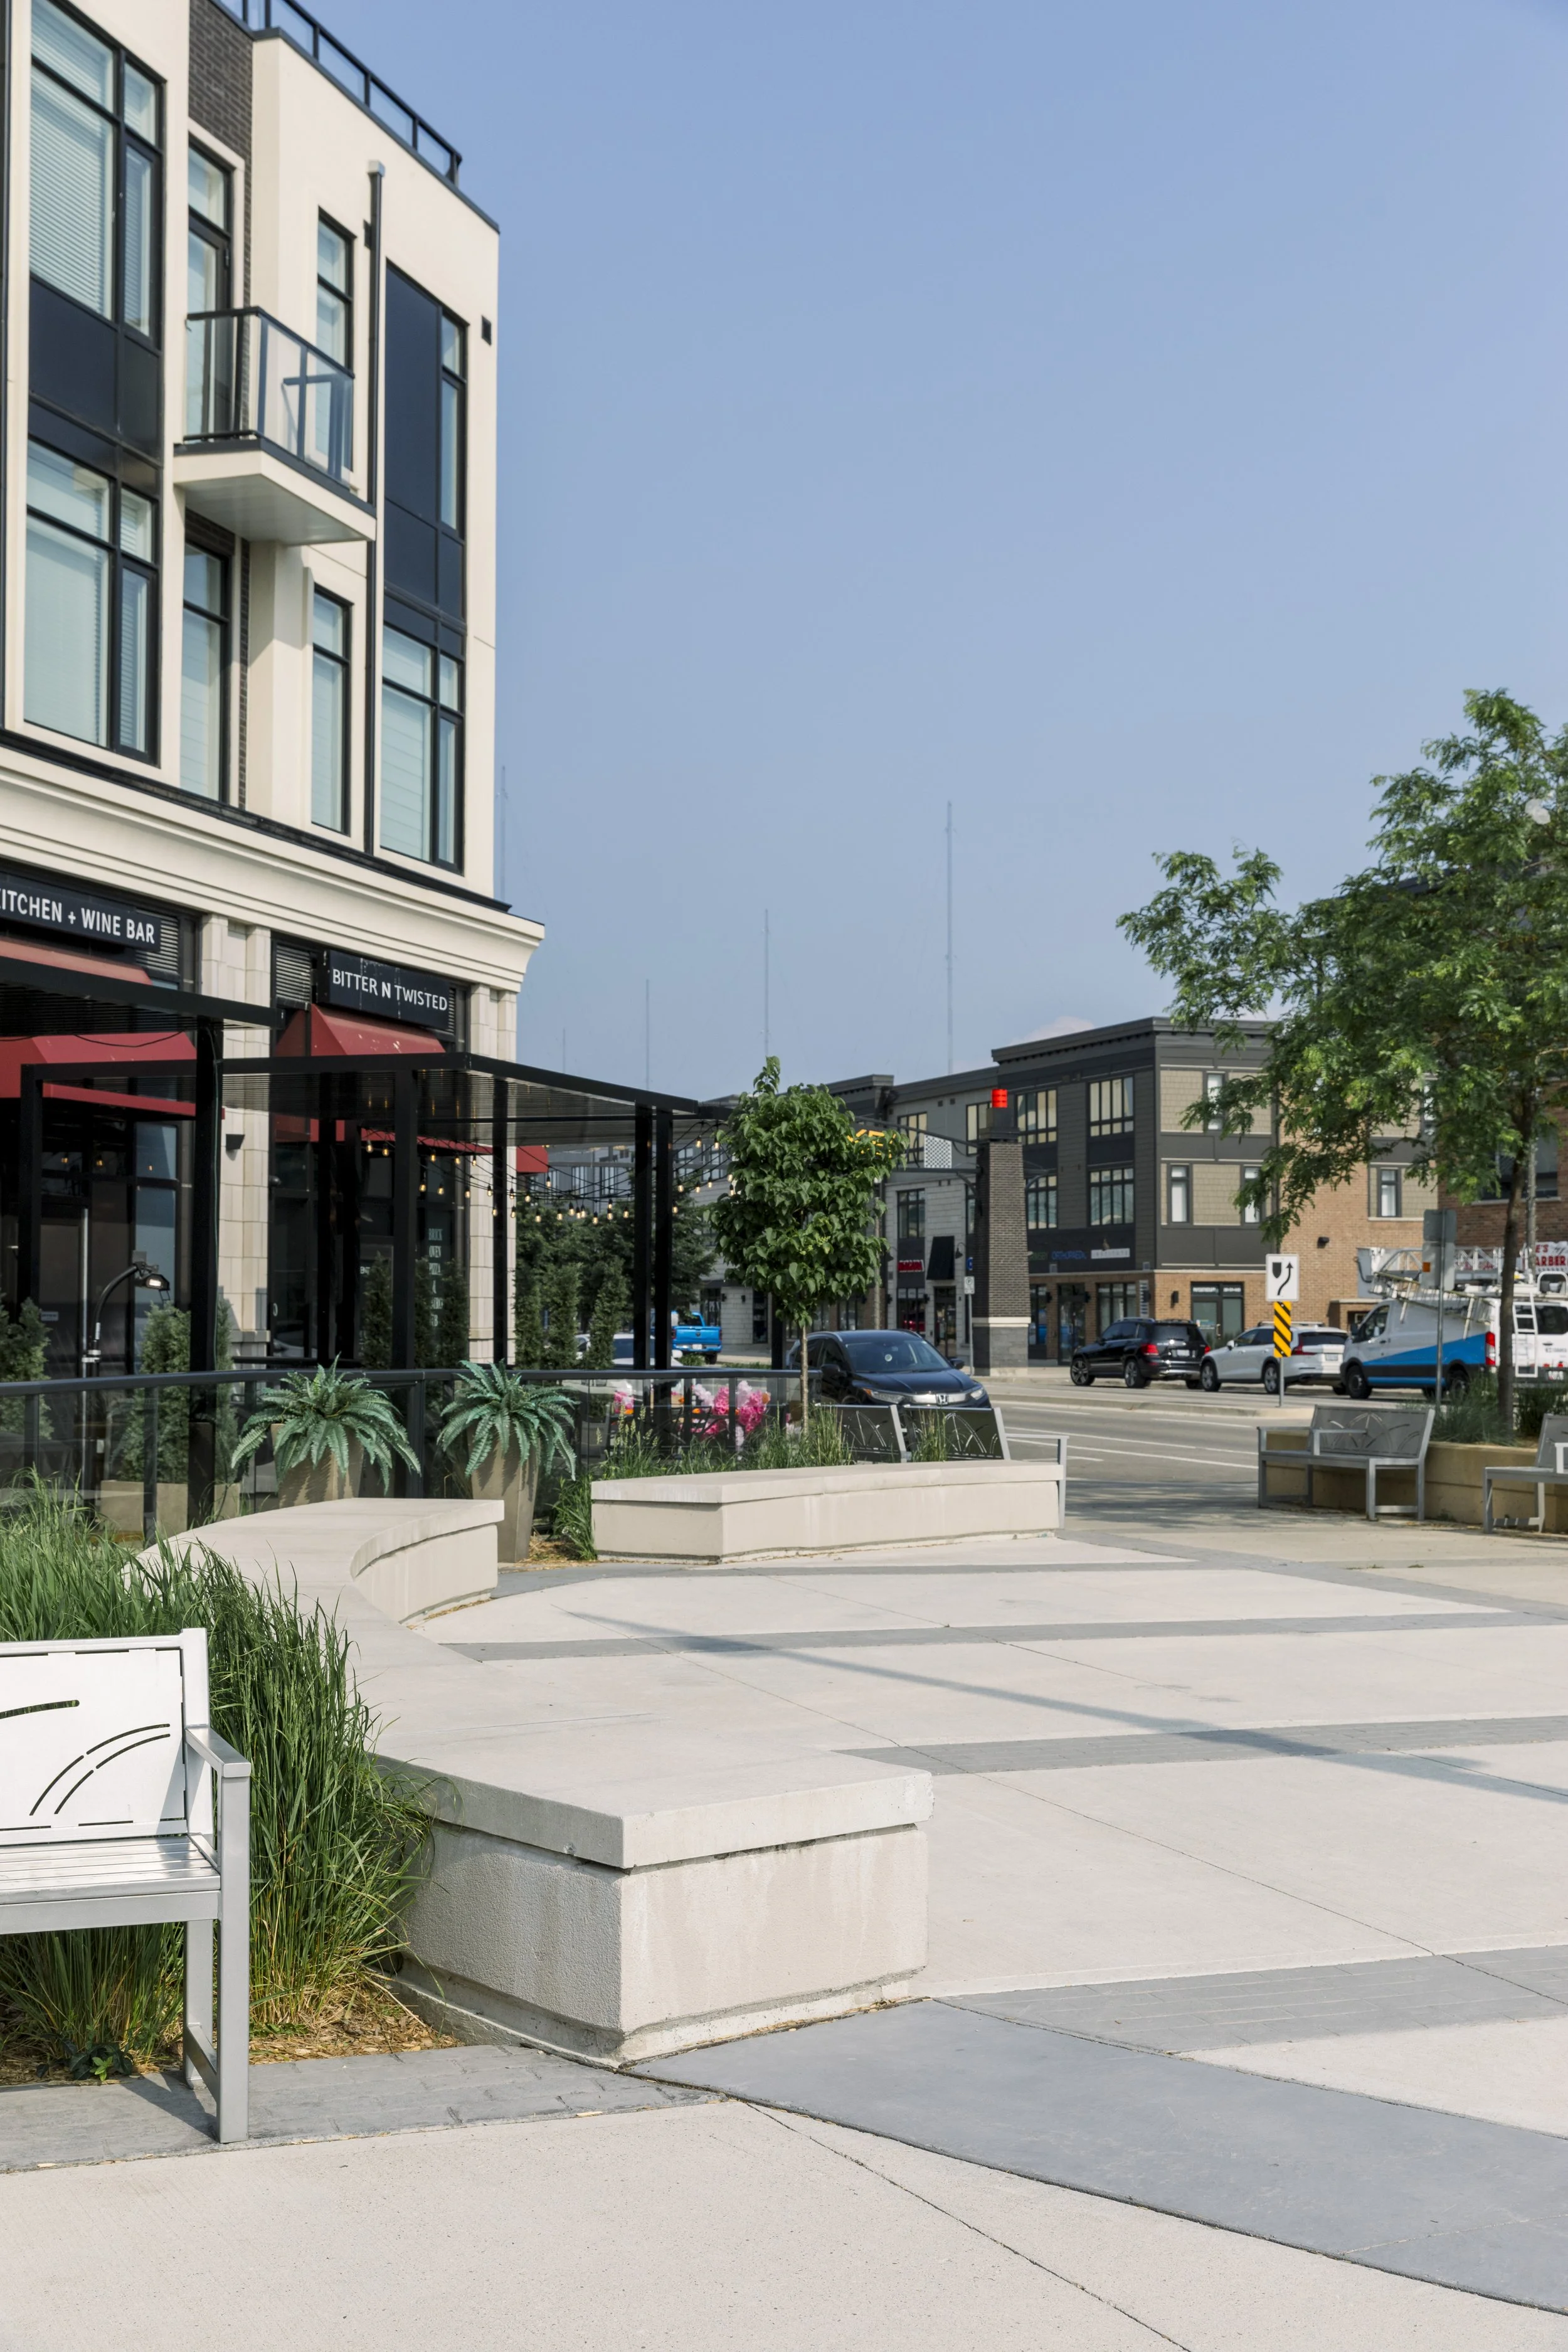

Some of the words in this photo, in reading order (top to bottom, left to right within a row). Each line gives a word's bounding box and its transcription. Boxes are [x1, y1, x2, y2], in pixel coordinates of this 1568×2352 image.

[0, 888, 62, 923] ITCHEN
[81, 908, 122, 936] WINE
[126, 919, 155, 944] BAR
[332, 969, 378, 996] BITTER
[381, 982, 391, 999] N
[394, 985, 448, 1011] TWISTED
[428, 1245, 442, 1258] OVEN
